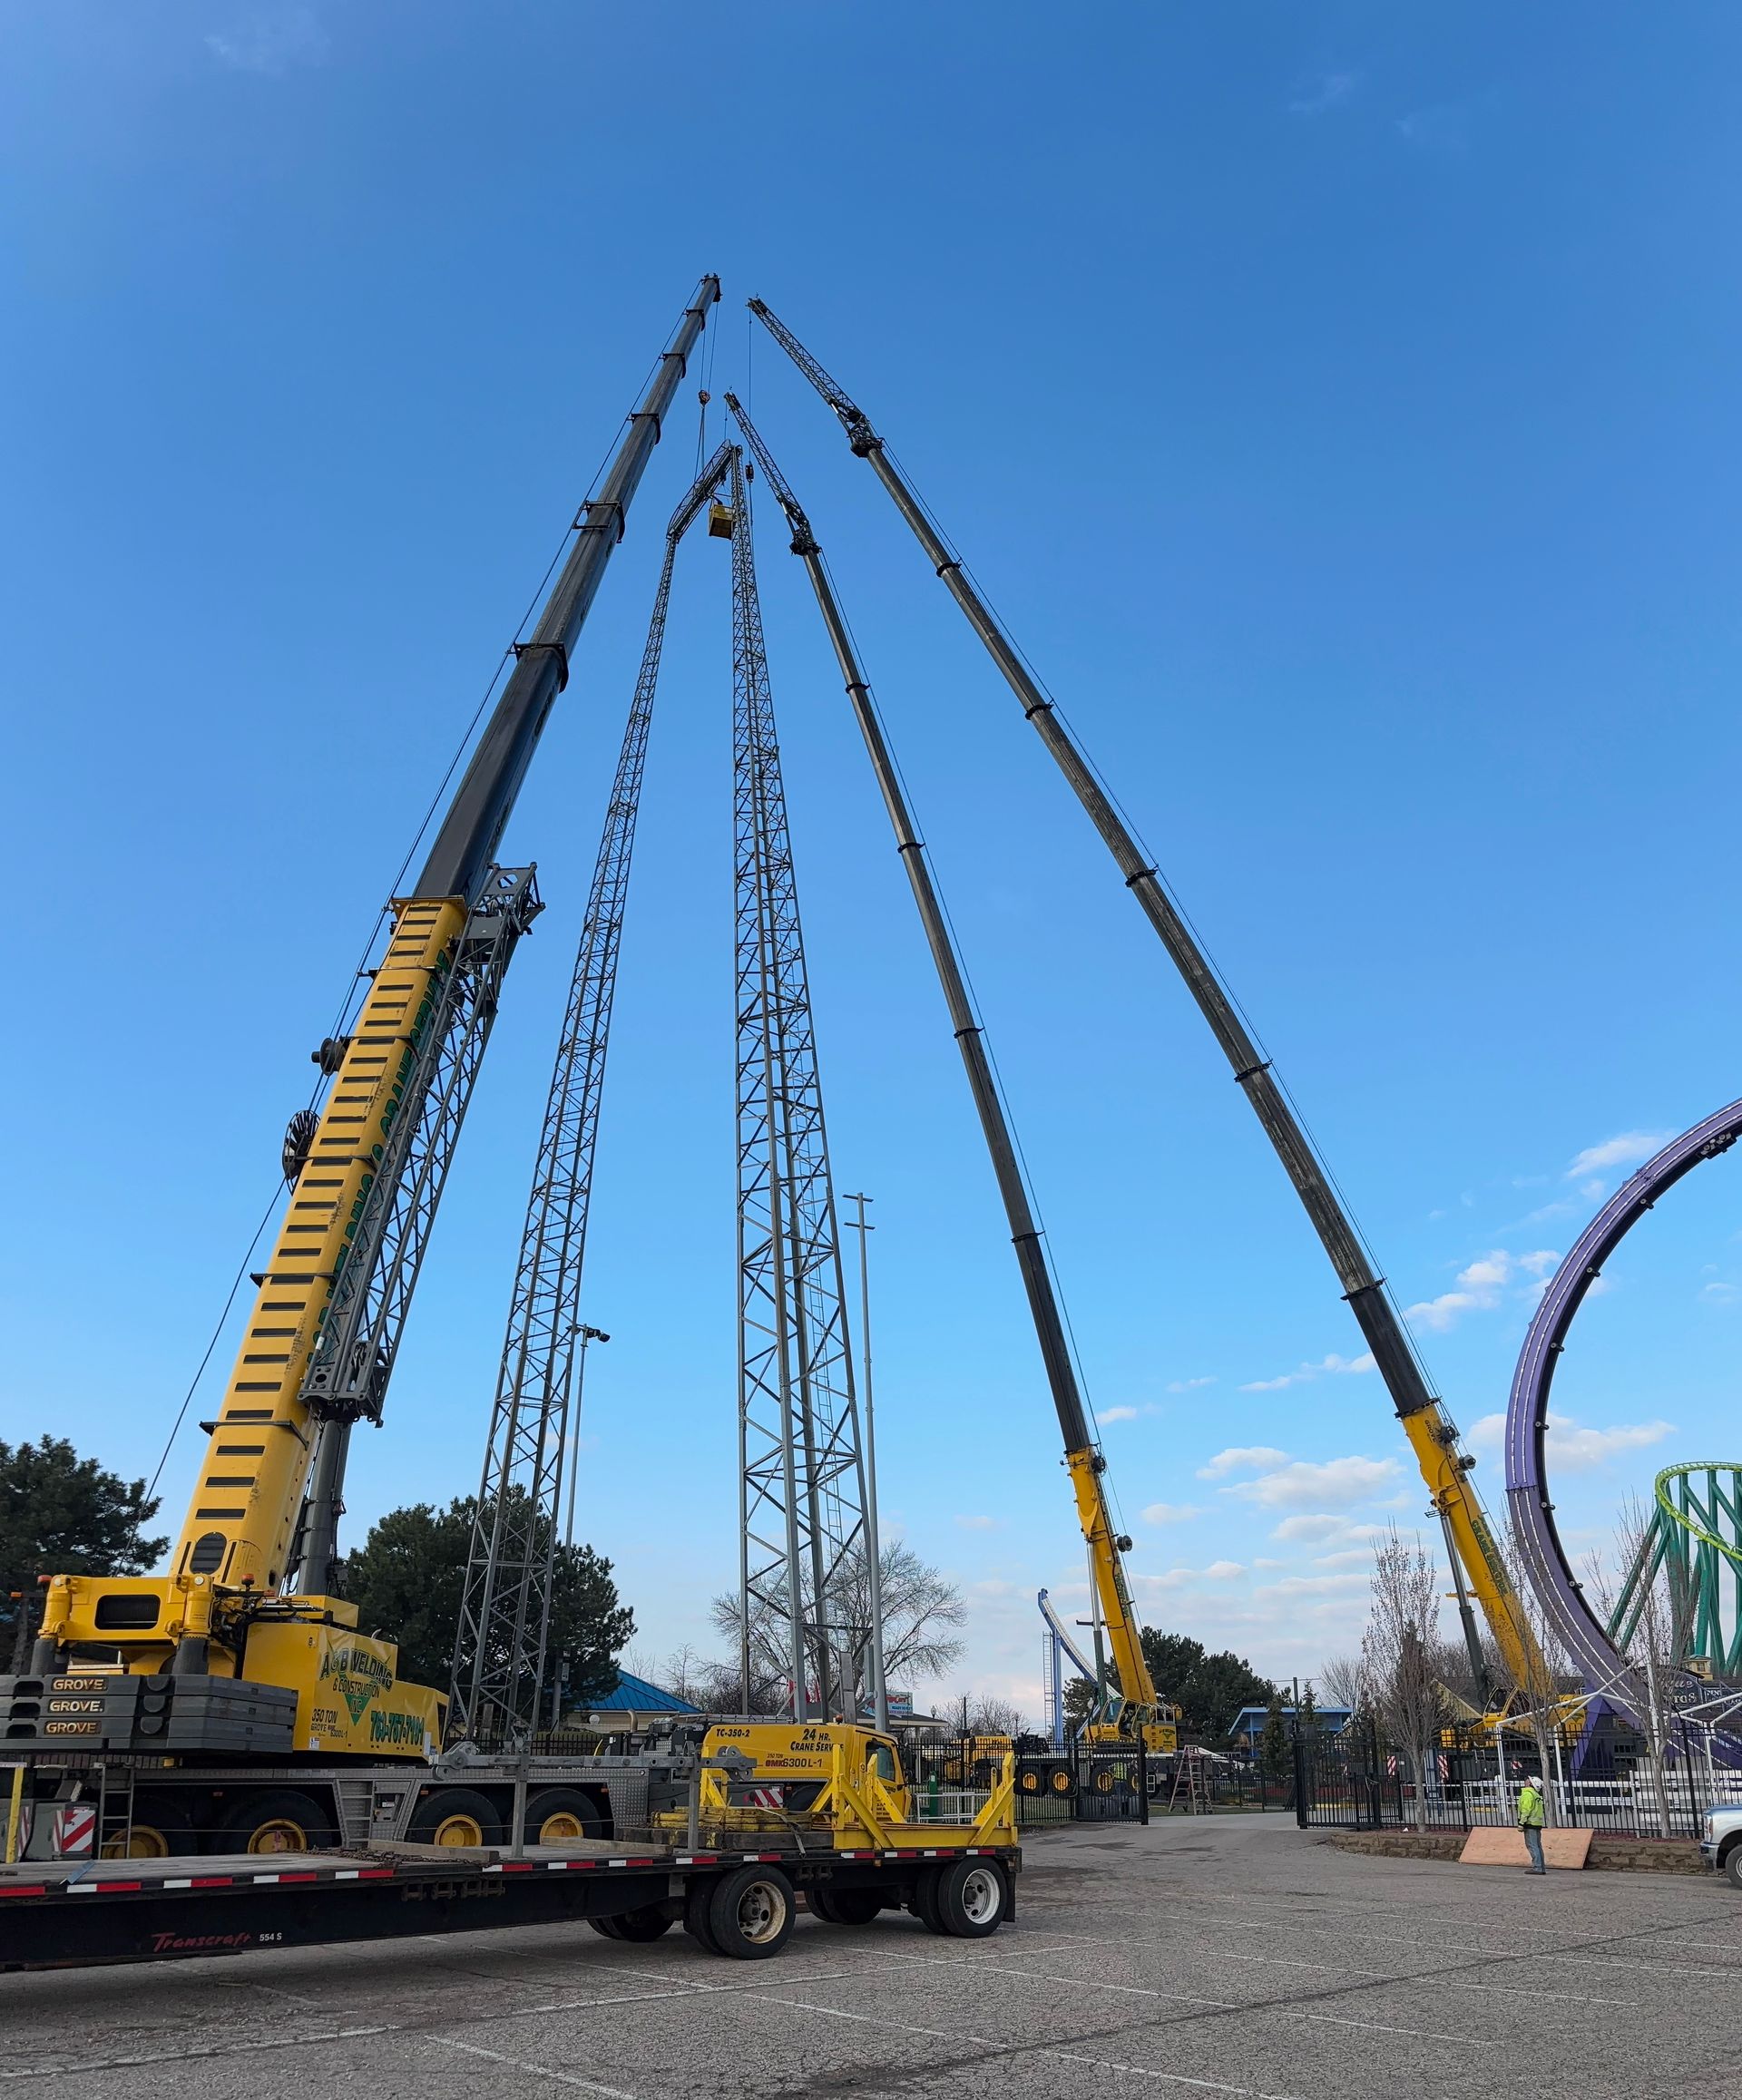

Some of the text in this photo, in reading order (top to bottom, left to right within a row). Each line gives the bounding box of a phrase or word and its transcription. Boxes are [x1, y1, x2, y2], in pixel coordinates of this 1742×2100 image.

[350, 1648, 393, 1693] WELDING
[333, 1677, 380, 1699] & CONSTRUCTION
[311, 1708, 338, 1724] 350 TON
[716, 1728, 750, 1738] TC-350-2
[803, 1728, 831, 1741] 24 HR.
[790, 1741, 815, 1751] CRANE
[151, 1931, 282, 1953] Transcraft 554 S
